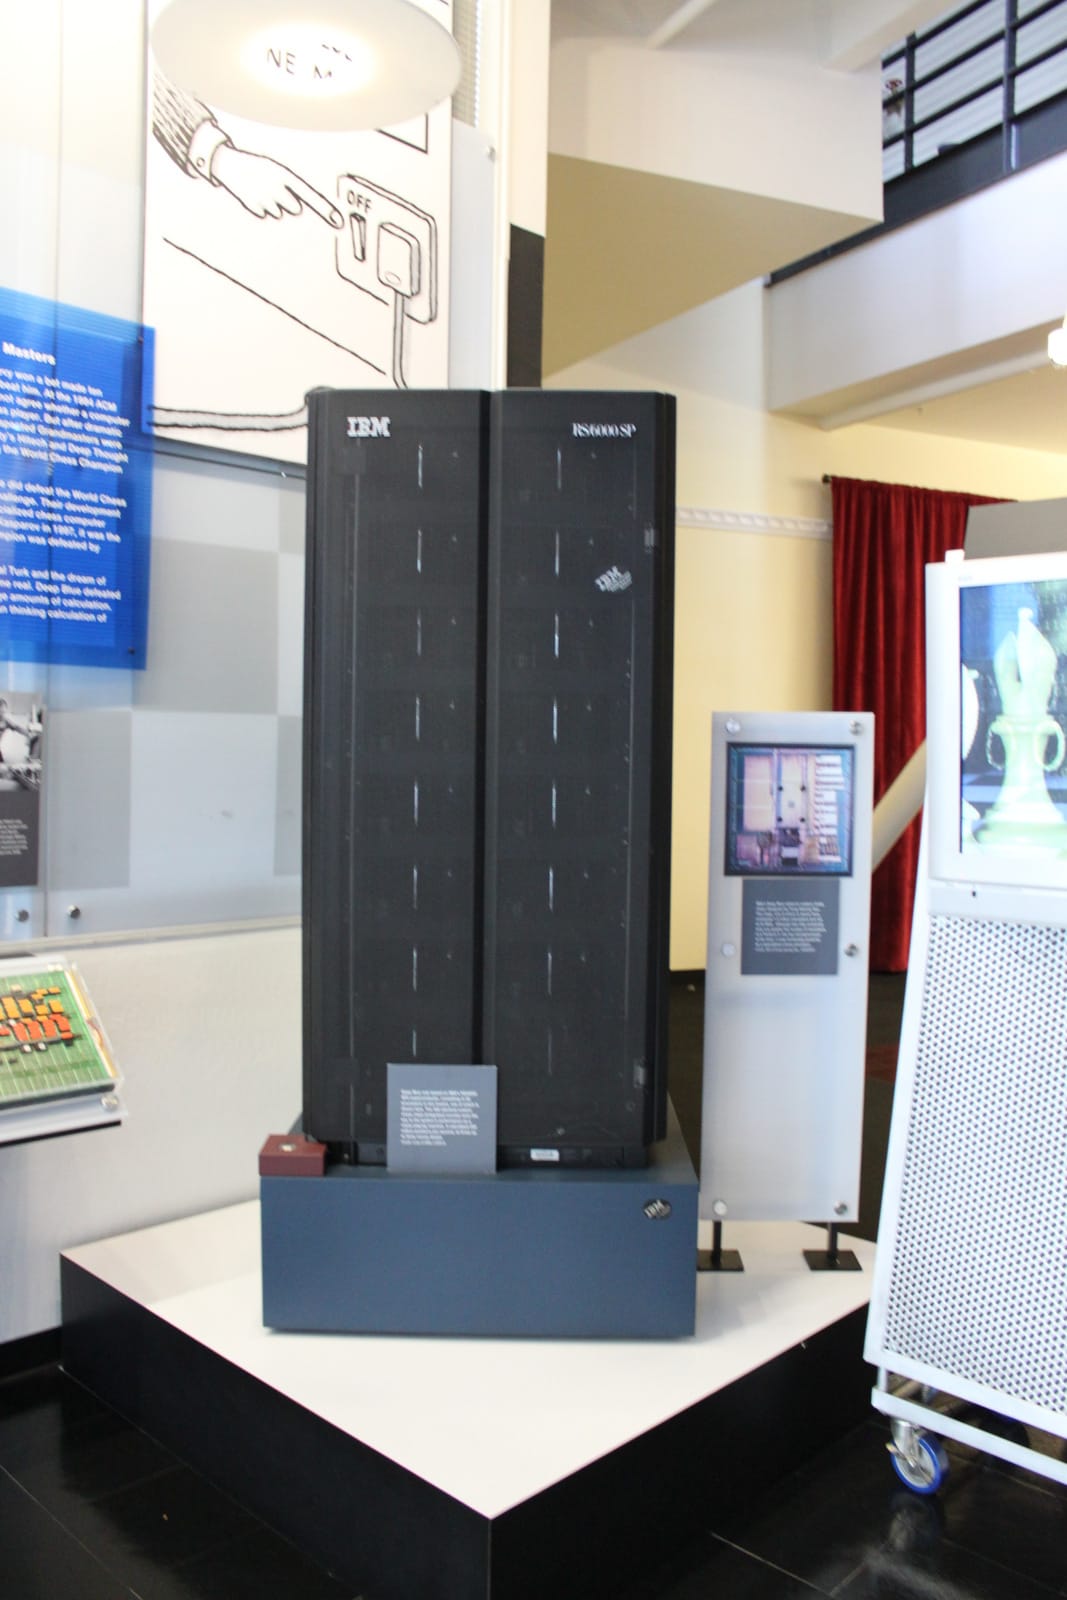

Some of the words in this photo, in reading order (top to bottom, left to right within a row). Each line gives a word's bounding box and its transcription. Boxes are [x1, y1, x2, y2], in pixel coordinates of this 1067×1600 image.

[346, 189, 373, 214] OFF
[2, 341, 56, 366] Masters
[346, 416, 391, 438] IBM
